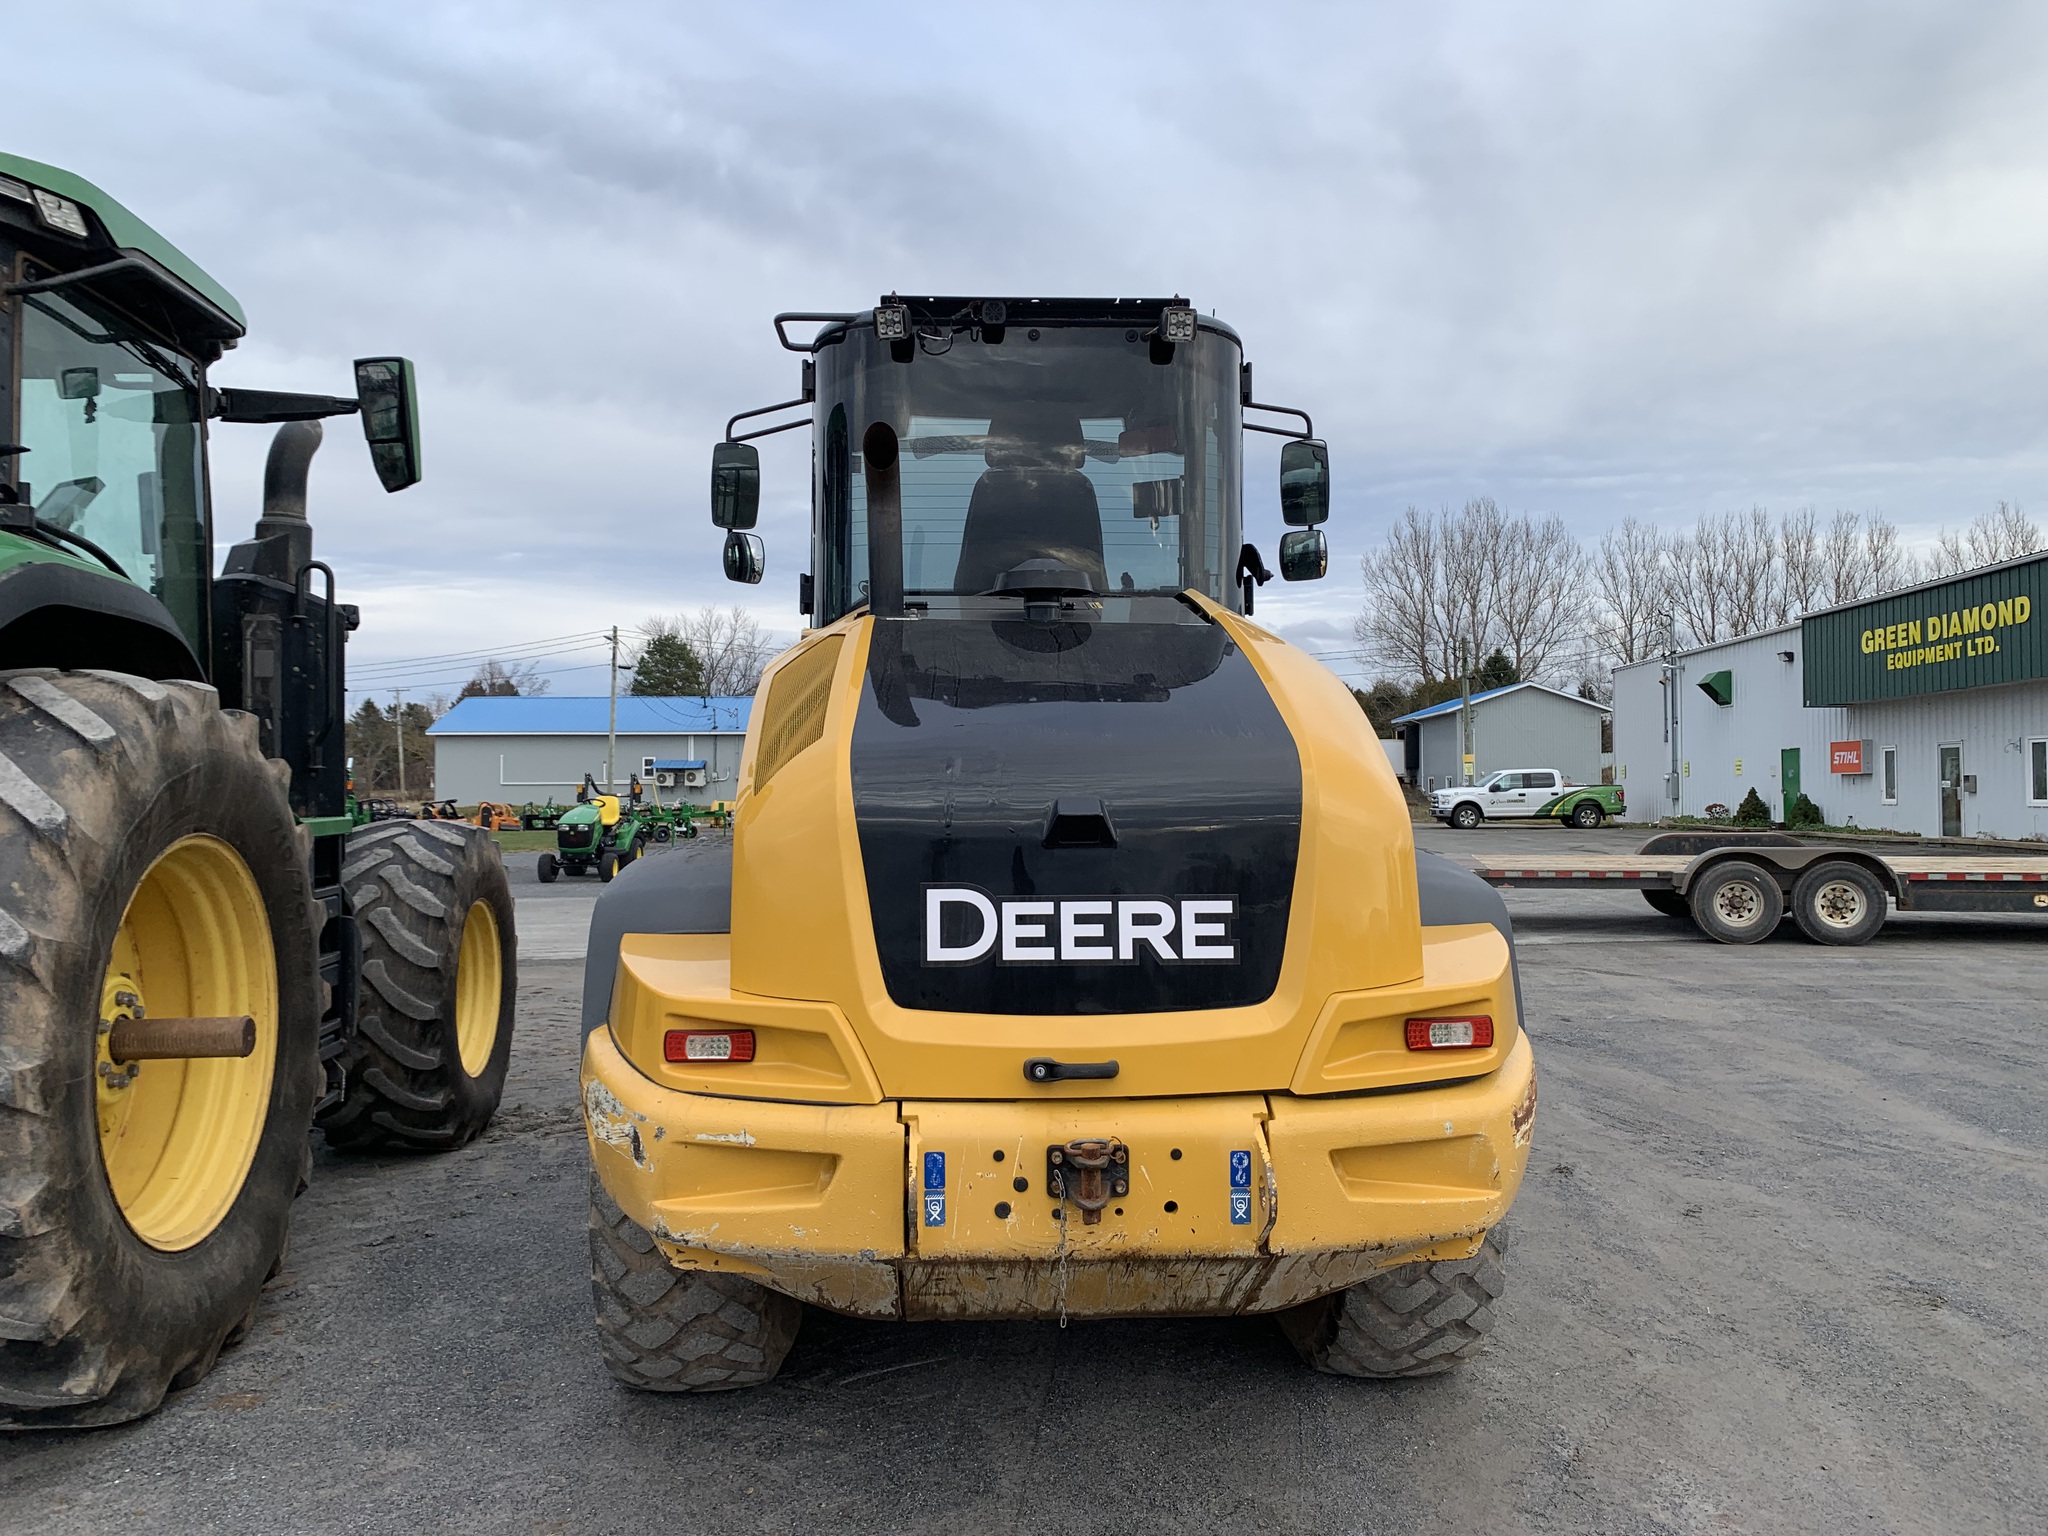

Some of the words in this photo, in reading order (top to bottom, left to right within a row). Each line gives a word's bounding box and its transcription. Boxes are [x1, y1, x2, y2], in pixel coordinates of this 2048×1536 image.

[1861, 620, 1922, 654] GREEN
[1927, 596, 2031, 642] DIAMOND
[1887, 641, 1962, 670] EQUIPMENT
[1967, 635, 2000, 658] LTD.
[1833, 751, 1859, 765] STIHL
[926, 889, 1234, 962] DEERE
